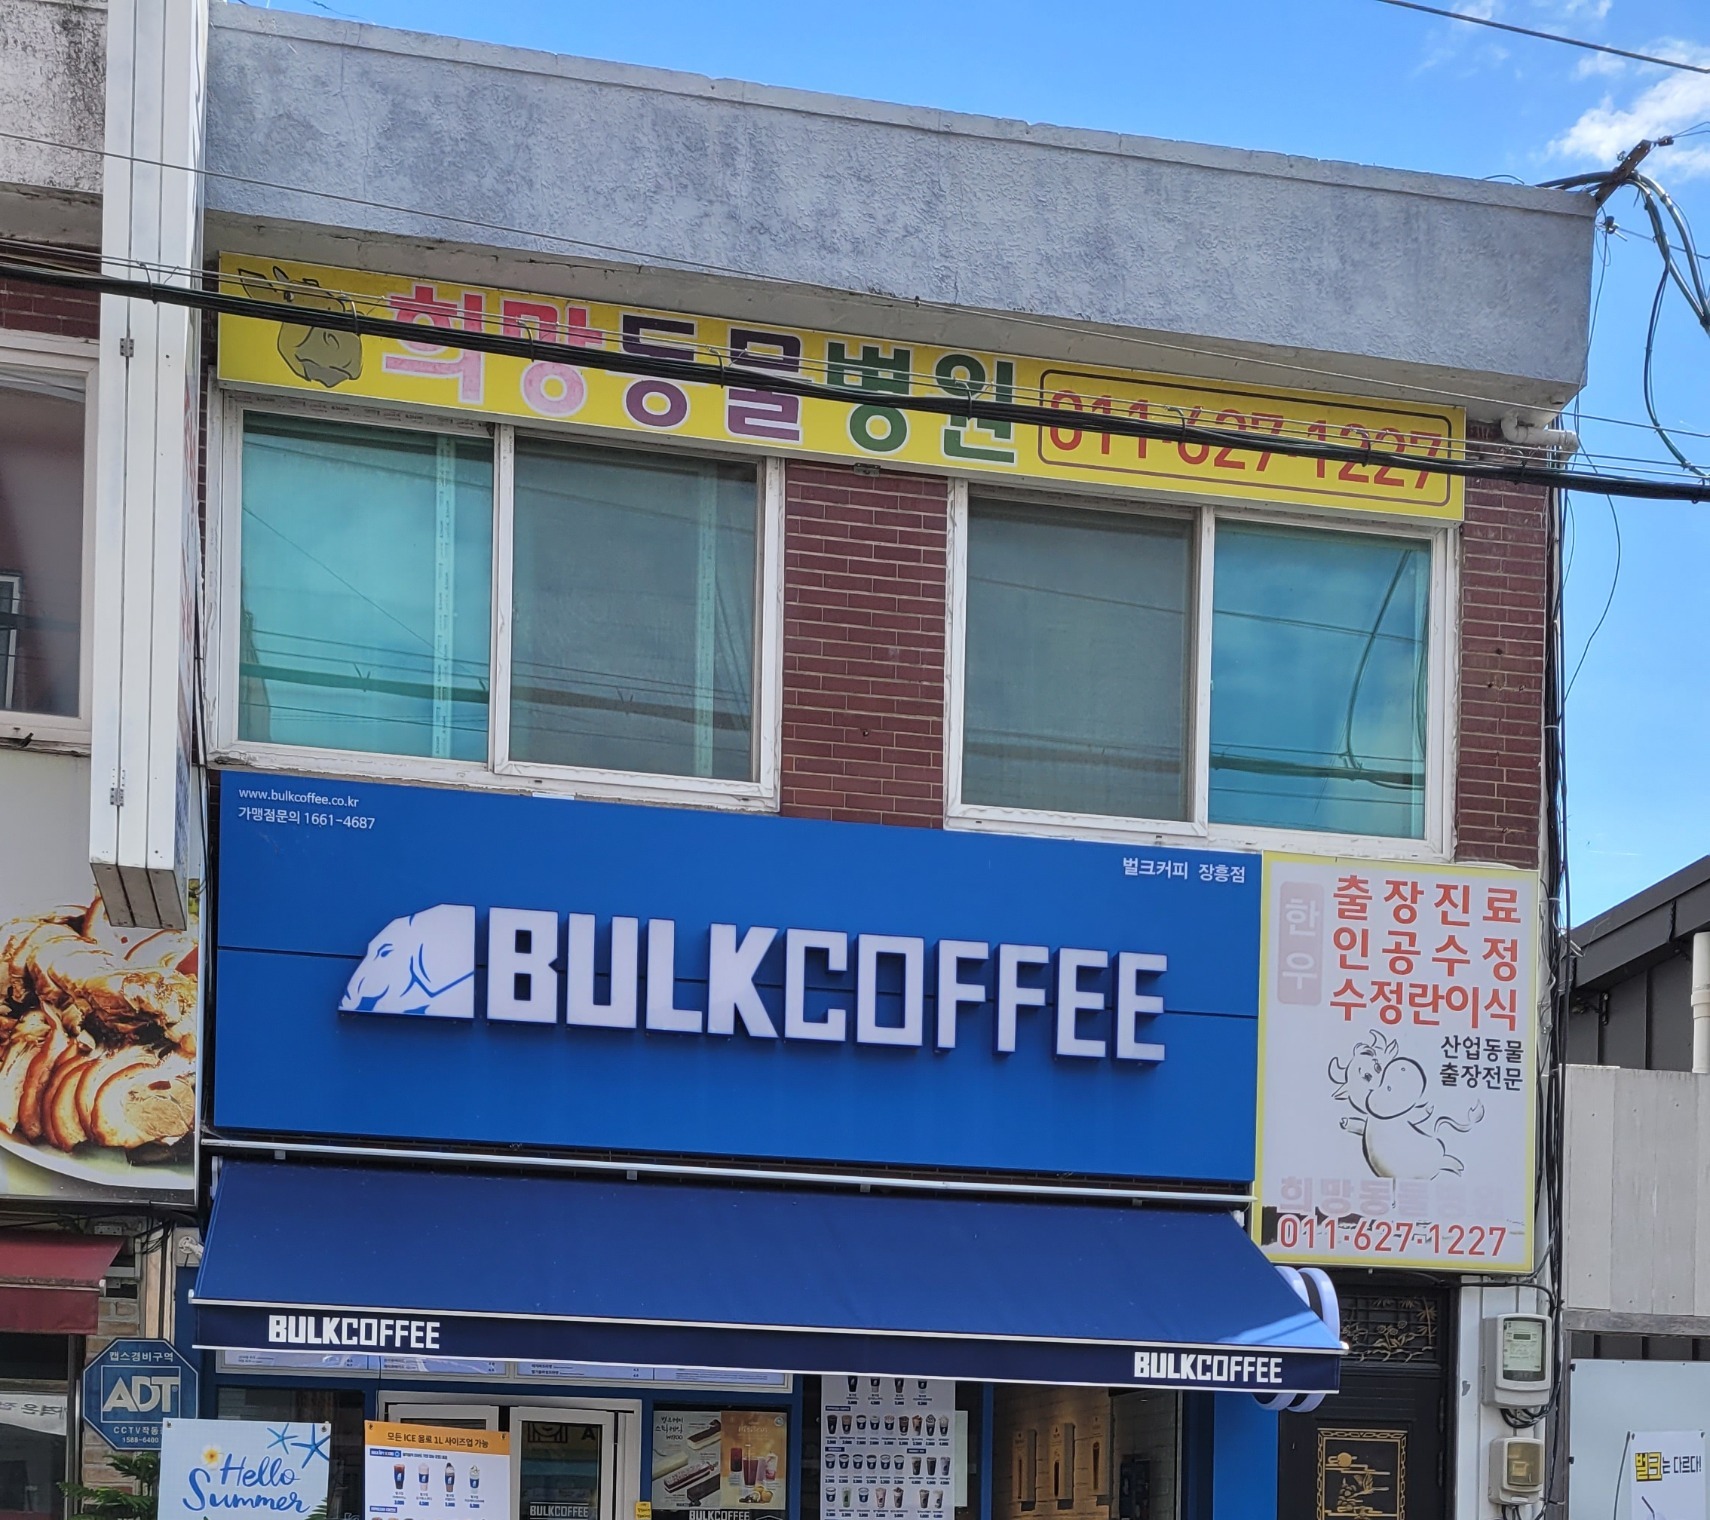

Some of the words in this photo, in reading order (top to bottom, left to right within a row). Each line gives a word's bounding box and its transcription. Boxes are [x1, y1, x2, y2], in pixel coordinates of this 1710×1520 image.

[238, 789, 360, 807] www.bulkcoffee.co.kr
[238, 807, 301, 825] 가맹점문의
[304, 812, 376, 829] 1661-4687
[1122, 857, 1189, 880] 벌크커피
[1198, 863, 1246, 884] 장흥점
[486, 905, 1169, 1062] BULKCOFFEE
[1329, 977, 1518, 1031] 수정란이식
[1440, 1035, 1525, 1065] 산업동물
[1439, 1062, 1525, 1092] 출장전문
[268, 1314, 441, 1350] BULKCOFFEE
[1133, 1351, 1283, 1384] BULKCOFFEE
[102, 1376, 180, 1413] ADT
[387, 1431, 403, 1441] 모든
[403, 1434, 416, 1443] ICE
[418, 1435, 433, 1444] 음료
[434, 1436, 443, 1445] 1L
[445, 1437, 473, 1448] 사이즈업
[474, 1439, 489, 1449] 가능
[220, 1453, 301, 1488] Hello
[1635, 1452, 1671, 1482] 벌크는
[1673, 1455, 1702, 1474] 다르다!
[182, 1467, 311, 1513] Summer
[529, 1505, 589, 1518] BULKCOFFEE
